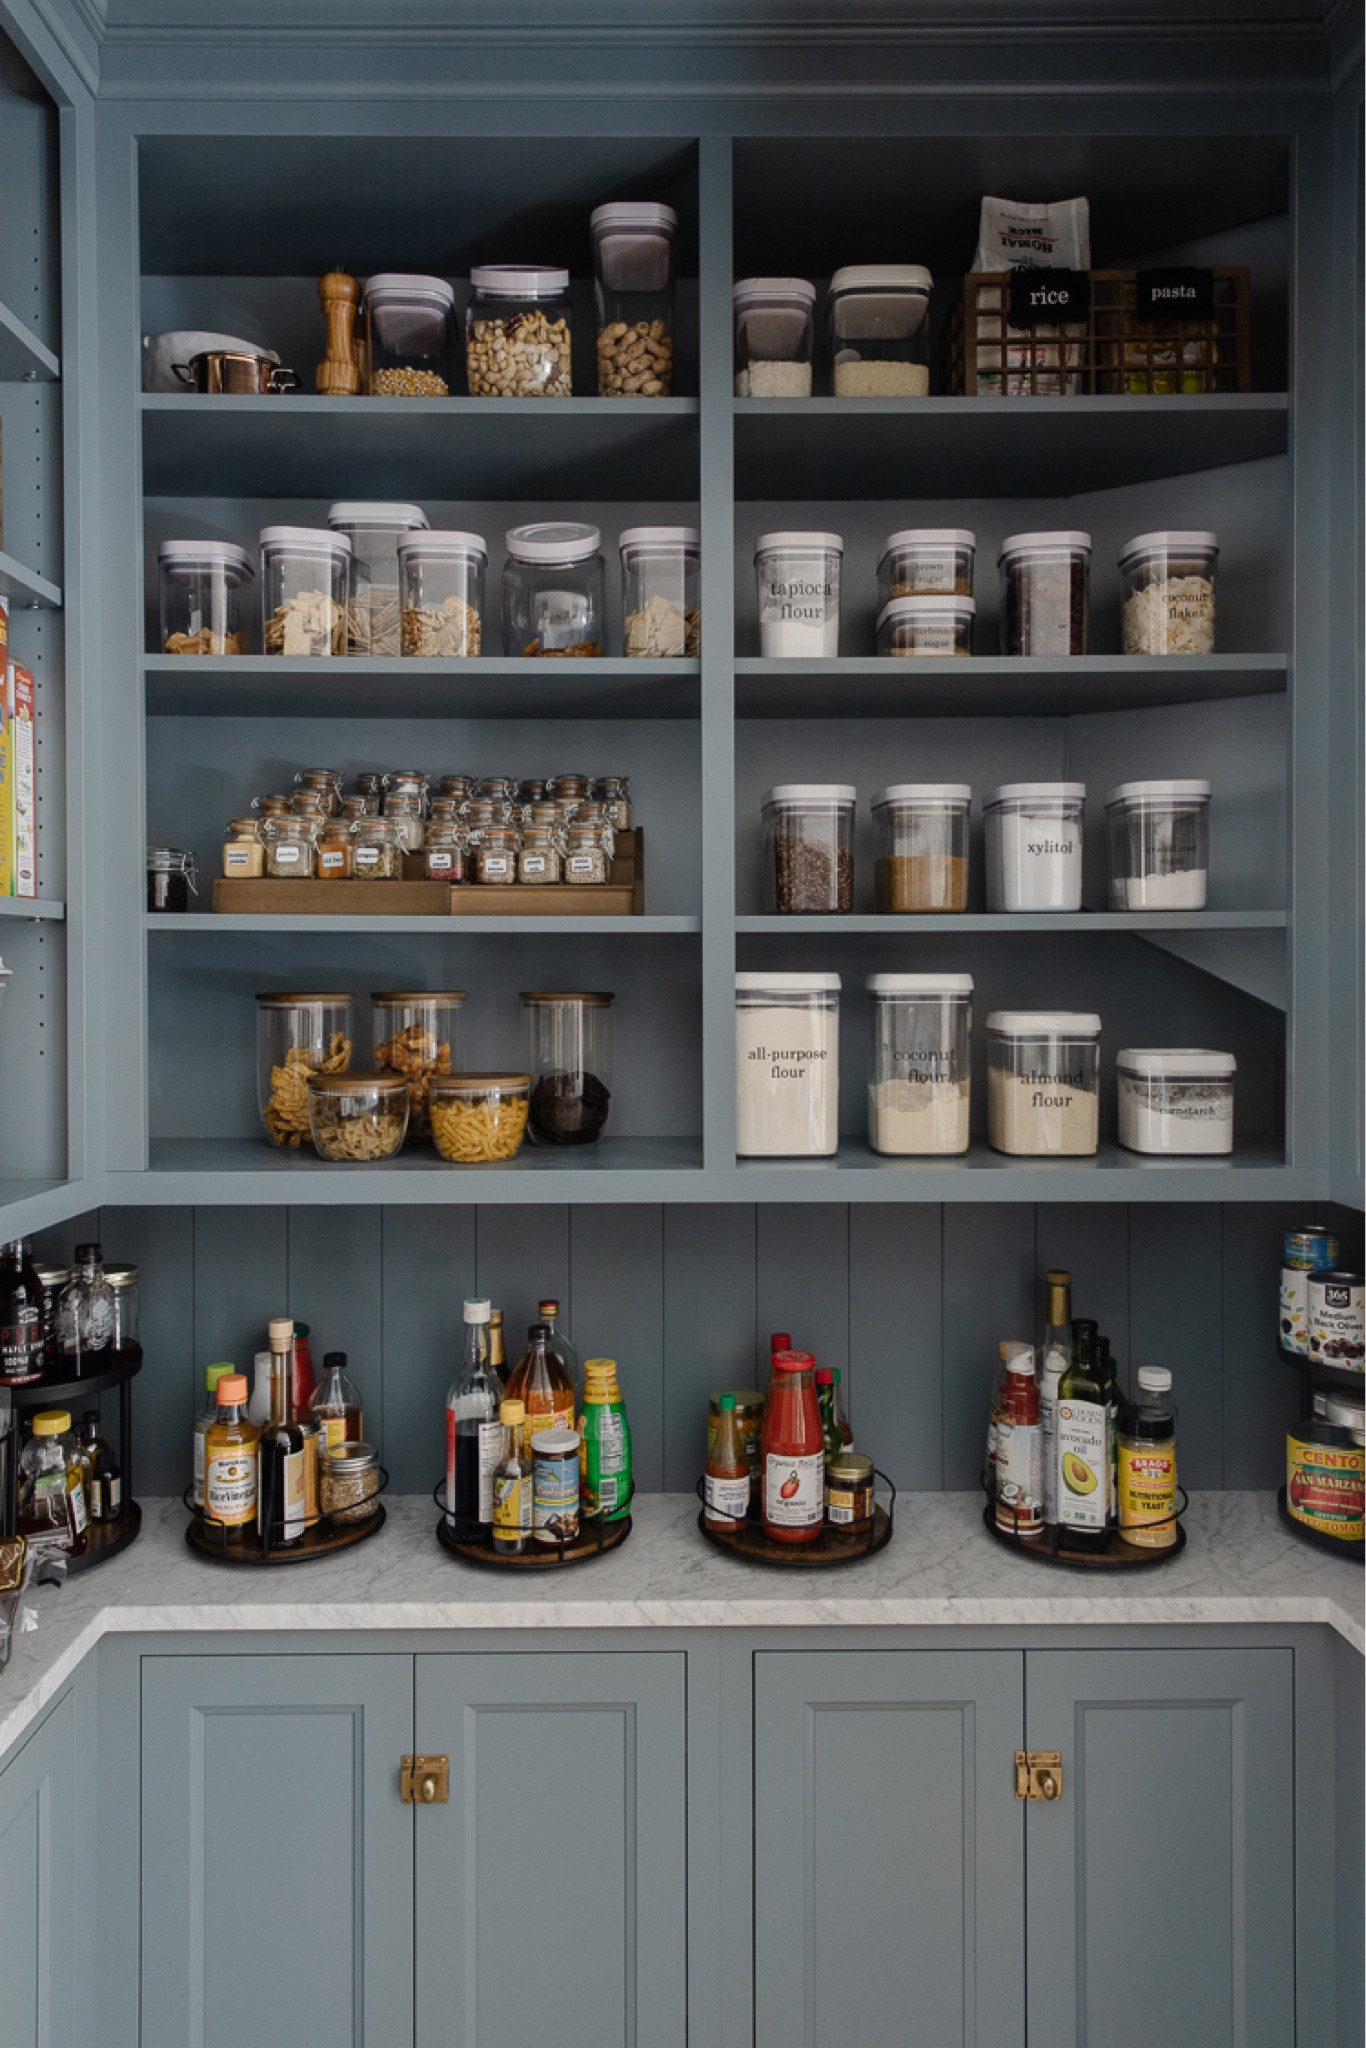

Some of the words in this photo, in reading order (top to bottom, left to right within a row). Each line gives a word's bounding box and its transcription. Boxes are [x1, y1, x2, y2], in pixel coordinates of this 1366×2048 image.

[1029, 285, 1069, 306] rice
[1151, 284, 1197, 302] pasta
[770, 579, 833, 599] tapioca
[1161, 593, 1208, 604] coconut
[781, 603, 824, 620] flour
[1168, 608, 1205, 620] flakes
[1027, 840, 1073, 856] xylitol
[747, 1046, 828, 1064] all-purpose
[892, 1048, 957, 1062] coconut
[770, 1065, 806, 1079] flour
[907, 1067, 948, 1083] flour
[1019, 1069, 1084, 1084] almond
[1031, 1091, 1073, 1108] flour
[1159, 1105, 1215, 1116] cornstarch
[1314, 1317, 1335, 1328] Black
[1319, 1310, 1357, 1321] Medium
[1058, 1433, 1102, 1446] avocado
[1073, 1445, 1088, 1454] oil
[1134, 1459, 1169, 1468] BRAGG
[1303, 1450, 1359, 1470] CENTO
[1295, 1474, 1313, 1485] SAN
[1128, 1490, 1173, 1501] NUTRITIONAL
[1141, 1501, 1165, 1510] YEAST
